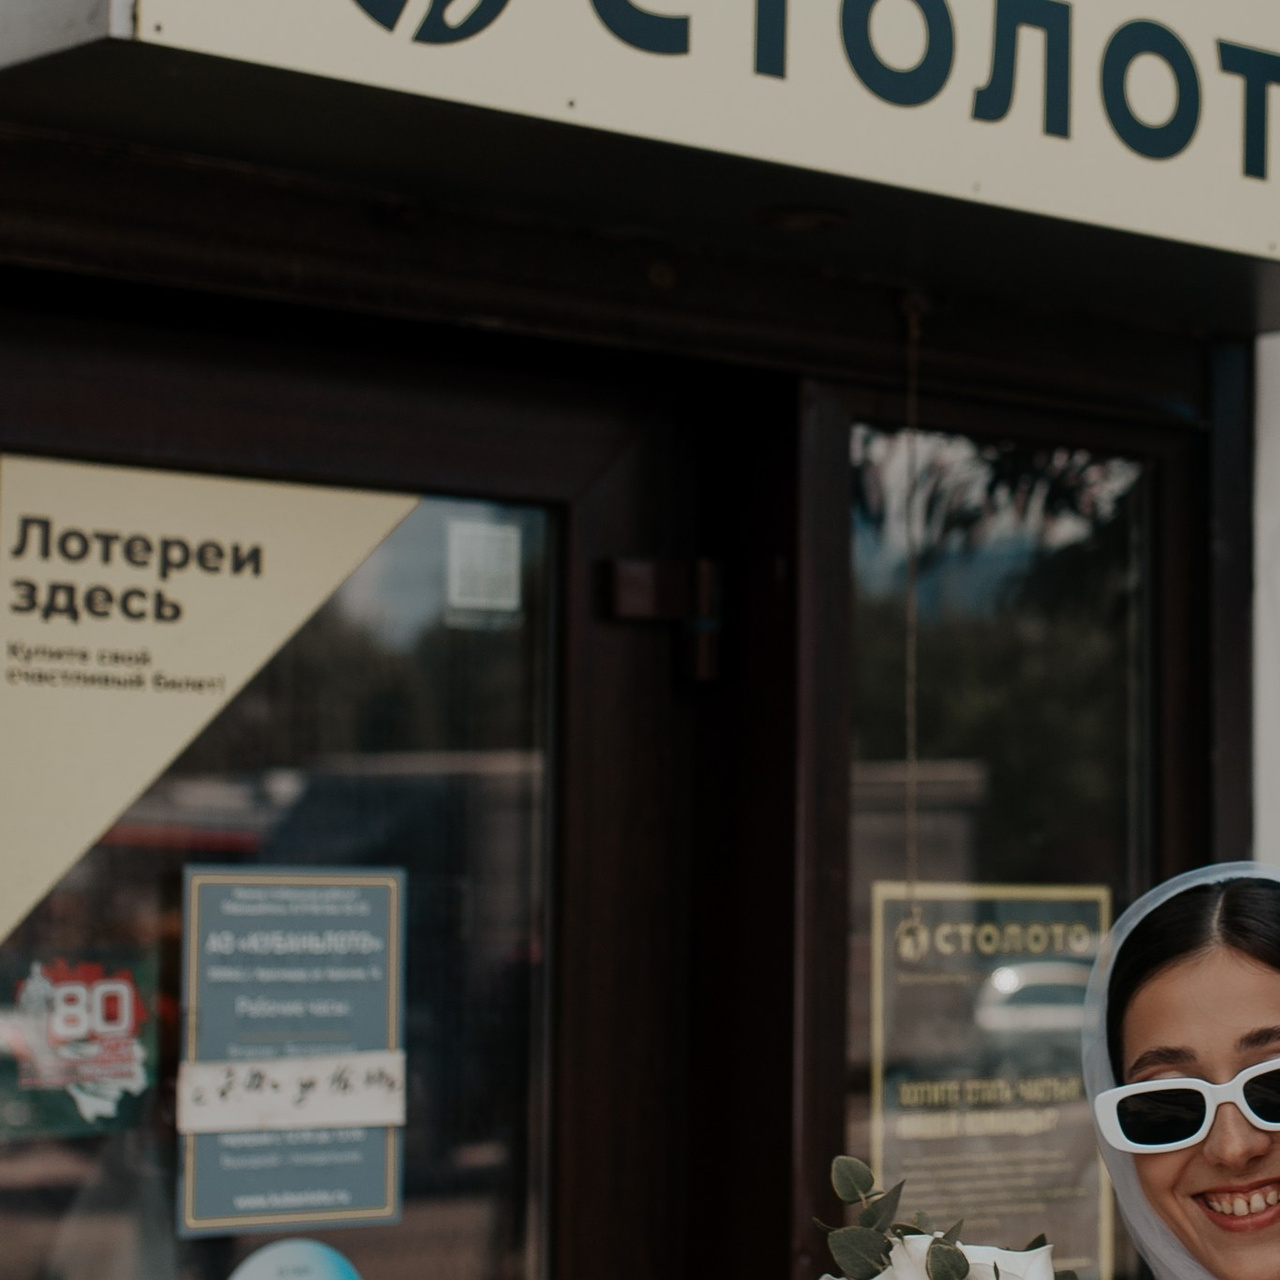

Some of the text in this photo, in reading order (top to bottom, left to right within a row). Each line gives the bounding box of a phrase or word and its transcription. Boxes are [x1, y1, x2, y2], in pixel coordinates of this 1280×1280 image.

[10, 515, 265, 578] Лотереи
[9, 577, 183, 623] здесь
[934, 922, 1092, 955] СТОЛОТО
[53, 979, 132, 1037] 80
